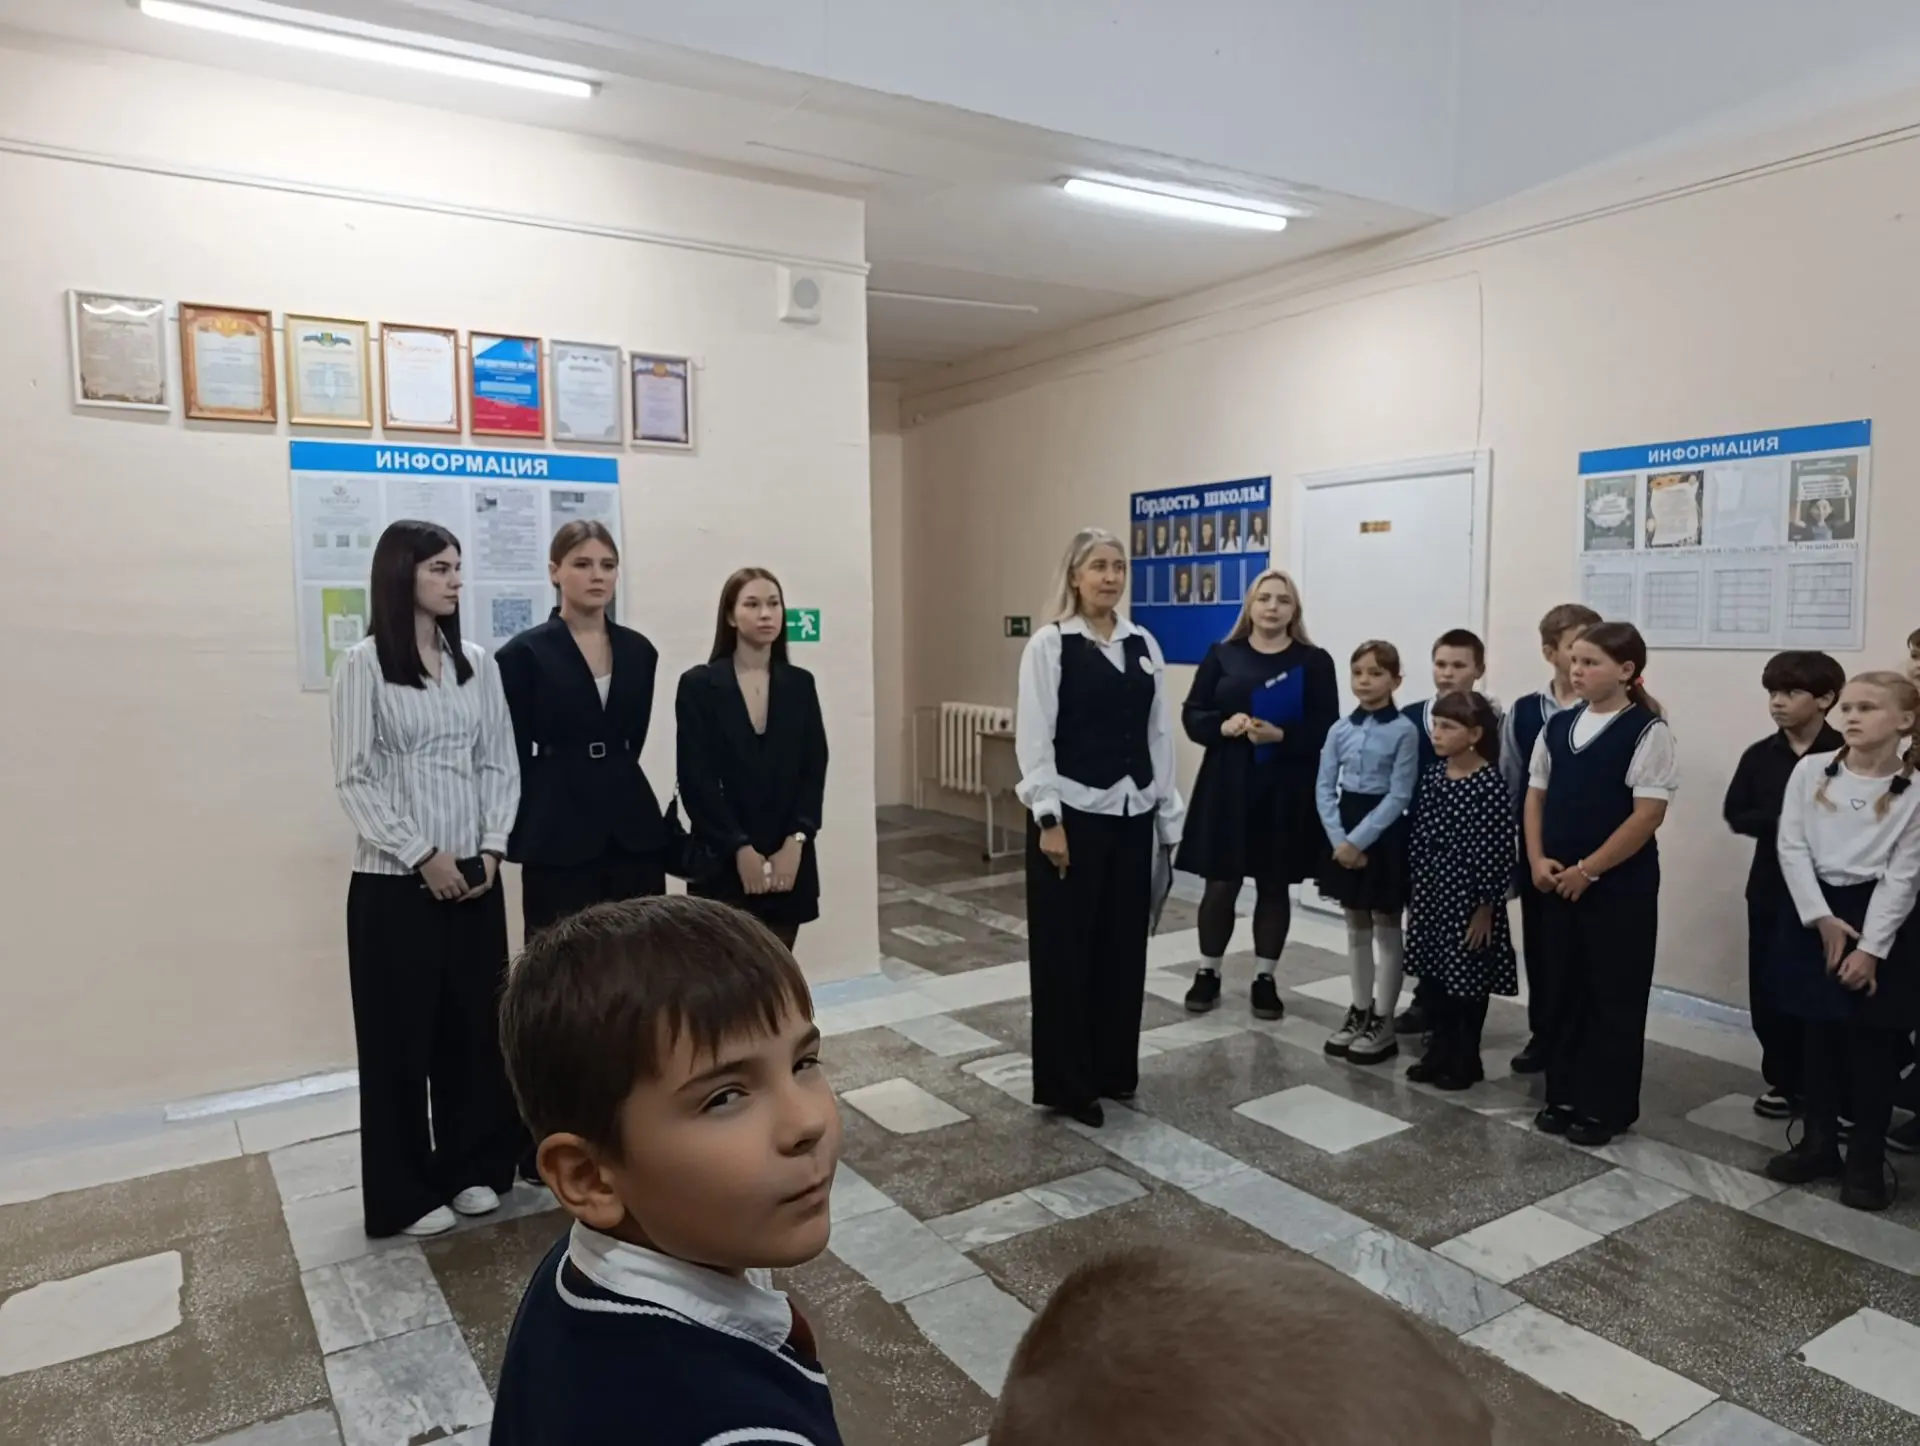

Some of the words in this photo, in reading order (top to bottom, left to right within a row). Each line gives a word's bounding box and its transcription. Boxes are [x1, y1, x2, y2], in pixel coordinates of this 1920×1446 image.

[1648, 436, 1779, 463] ИНФОРМАЦИЯ
[376, 450, 548, 478] ИНФОРМАЦИЯ
[1135, 494, 1200, 519] Гордость
[1204, 484, 1266, 507] школы
